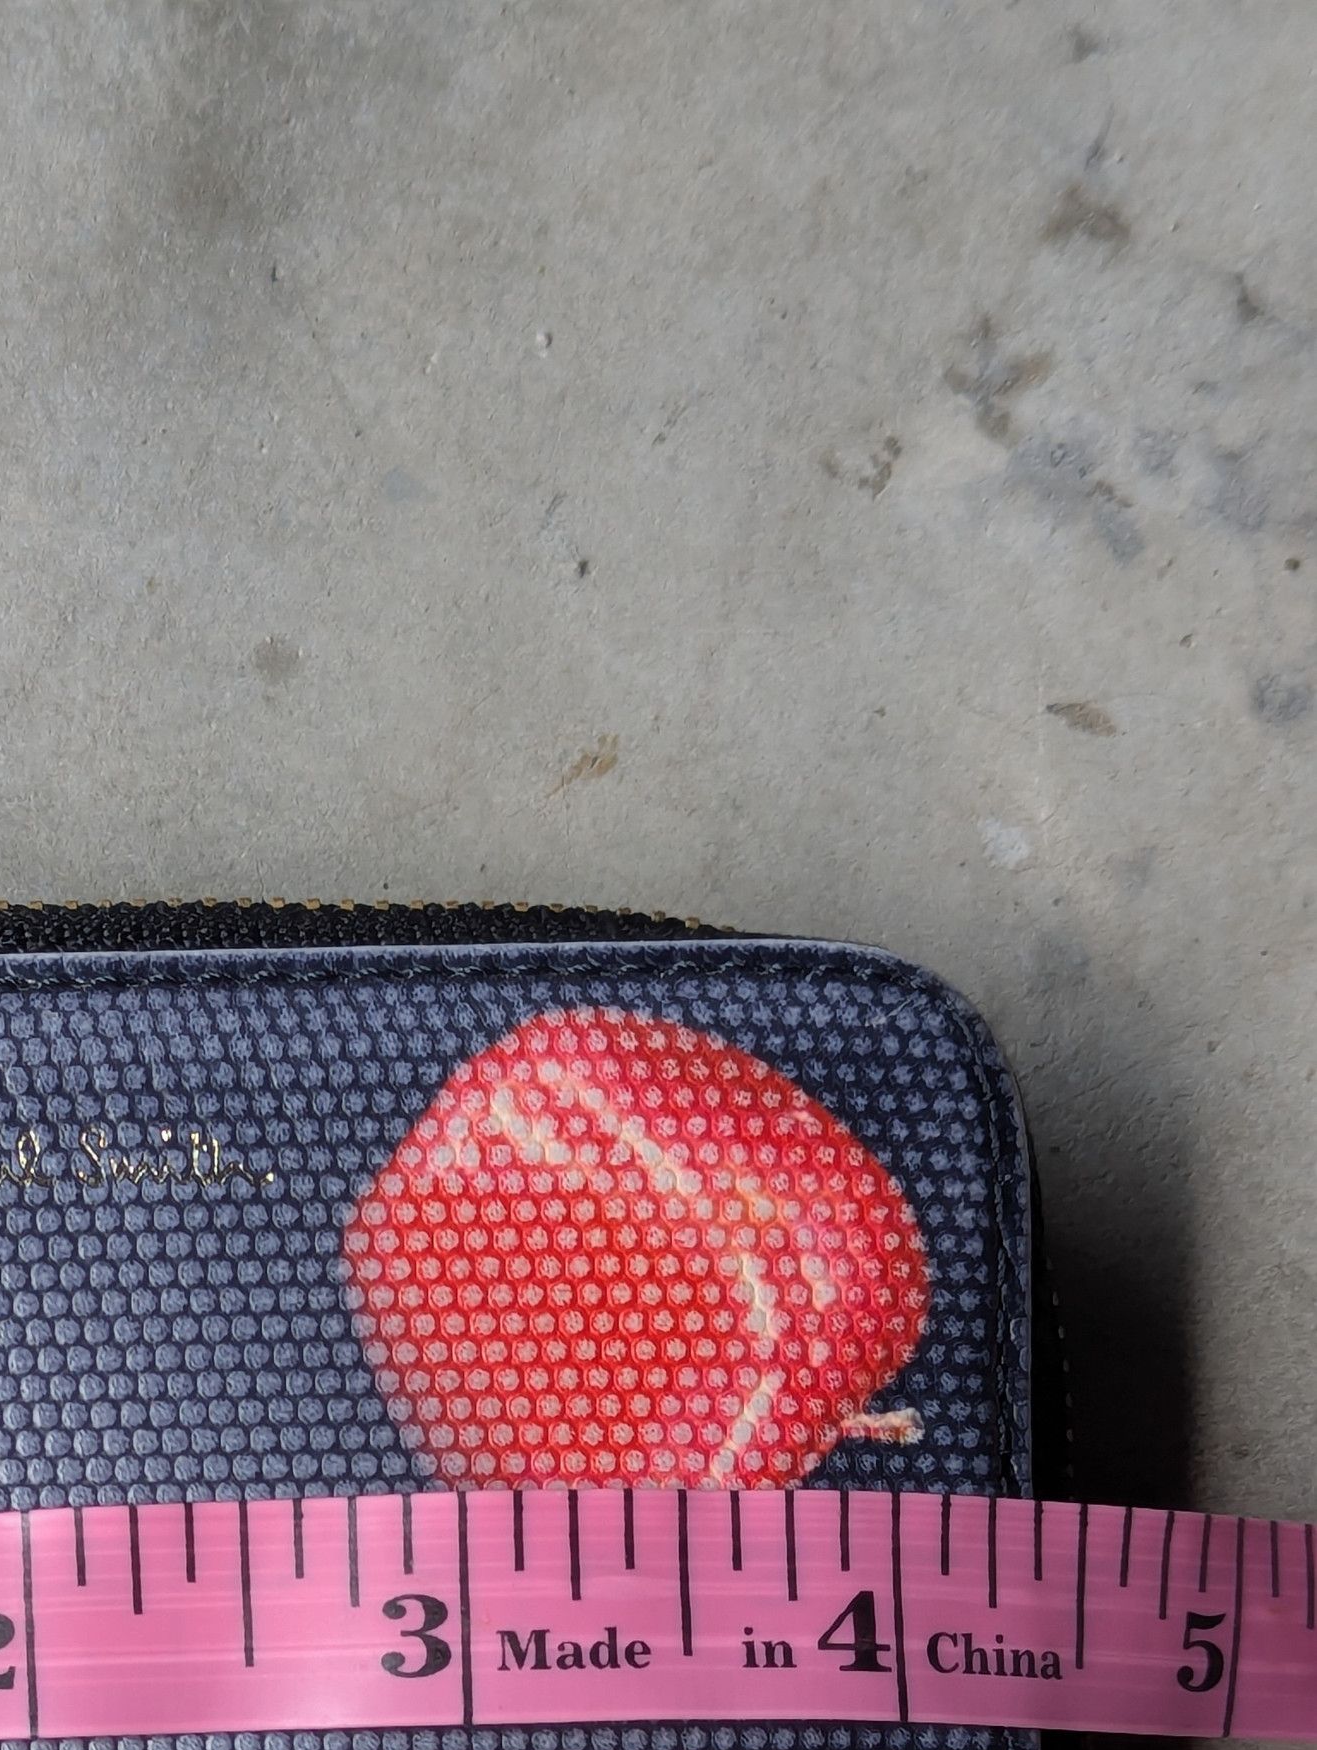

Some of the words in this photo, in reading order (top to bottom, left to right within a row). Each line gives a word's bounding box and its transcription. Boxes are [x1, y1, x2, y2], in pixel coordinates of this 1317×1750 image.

[380, 1592, 452, 1678] 3
[496, 1628, 653, 1672] Made
[742, 1625, 798, 1670] in
[926, 1629, 1064, 1681] China
[817, 1590, 892, 1674] 4
[1175, 1610, 1228, 1693] 5
